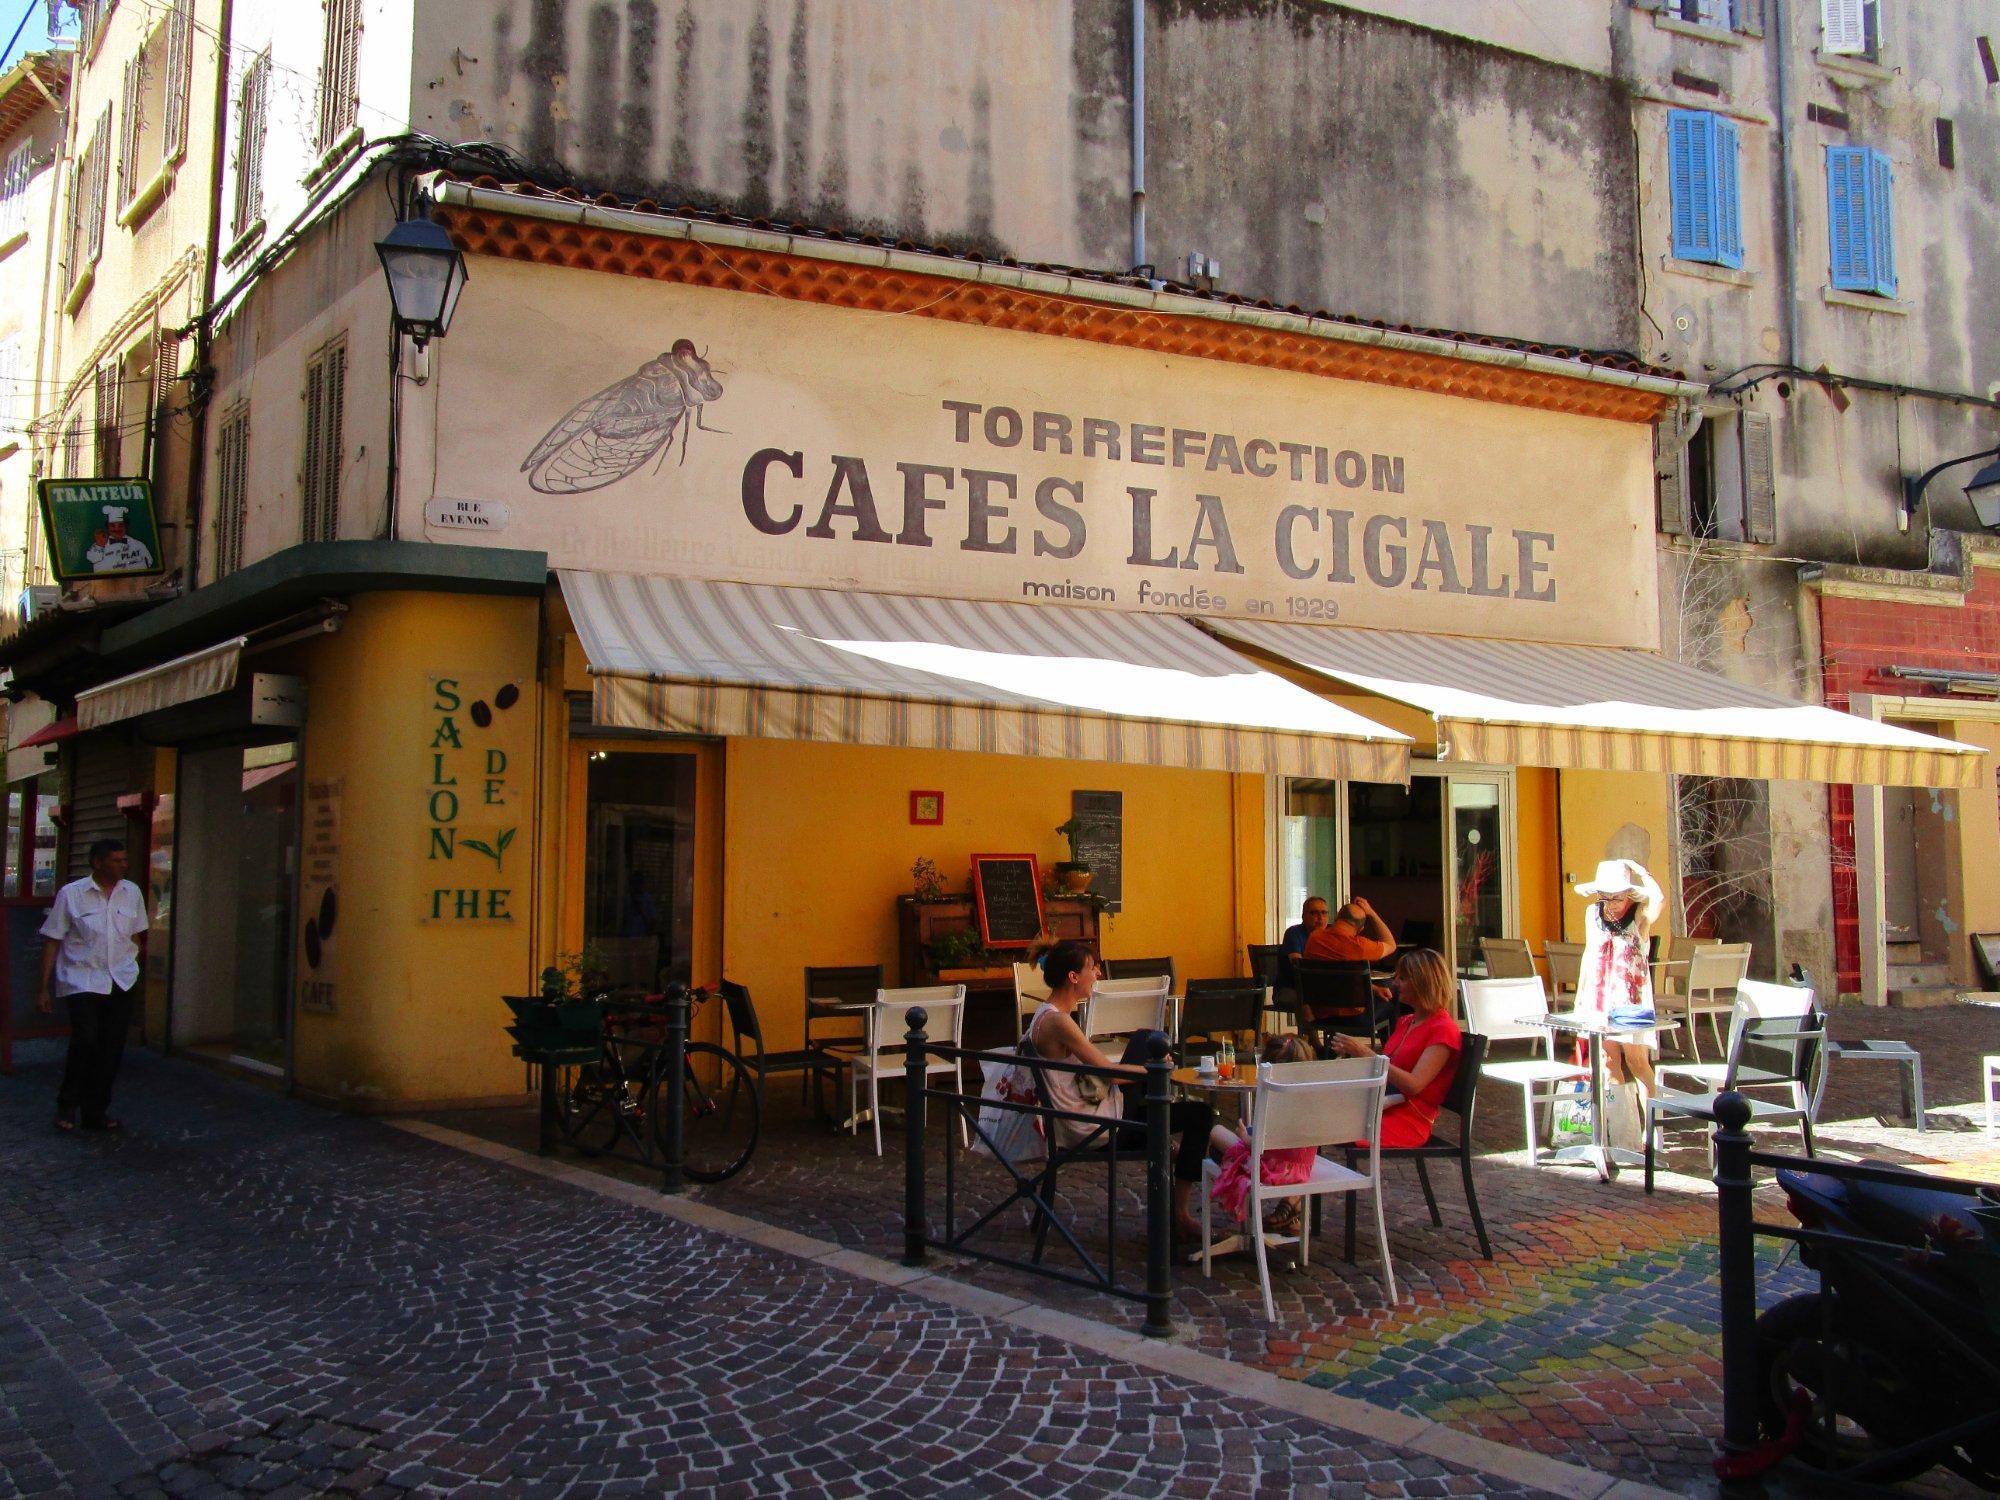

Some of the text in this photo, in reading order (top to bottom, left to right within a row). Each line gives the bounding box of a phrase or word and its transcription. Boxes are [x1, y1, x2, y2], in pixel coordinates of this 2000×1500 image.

[942, 399, 1405, 494] TORREFACTION
[52, 485, 144, 502] TRAITEUR
[457, 502, 481, 512] RUE
[441, 513, 489, 526] EVENOS
[741, 447, 1556, 603] CAFES LA CIGALE
[1022, 578, 1340, 620] maison fondée en 1929
[428, 678, 463, 861] SALON
[484, 749, 508, 805] DE
